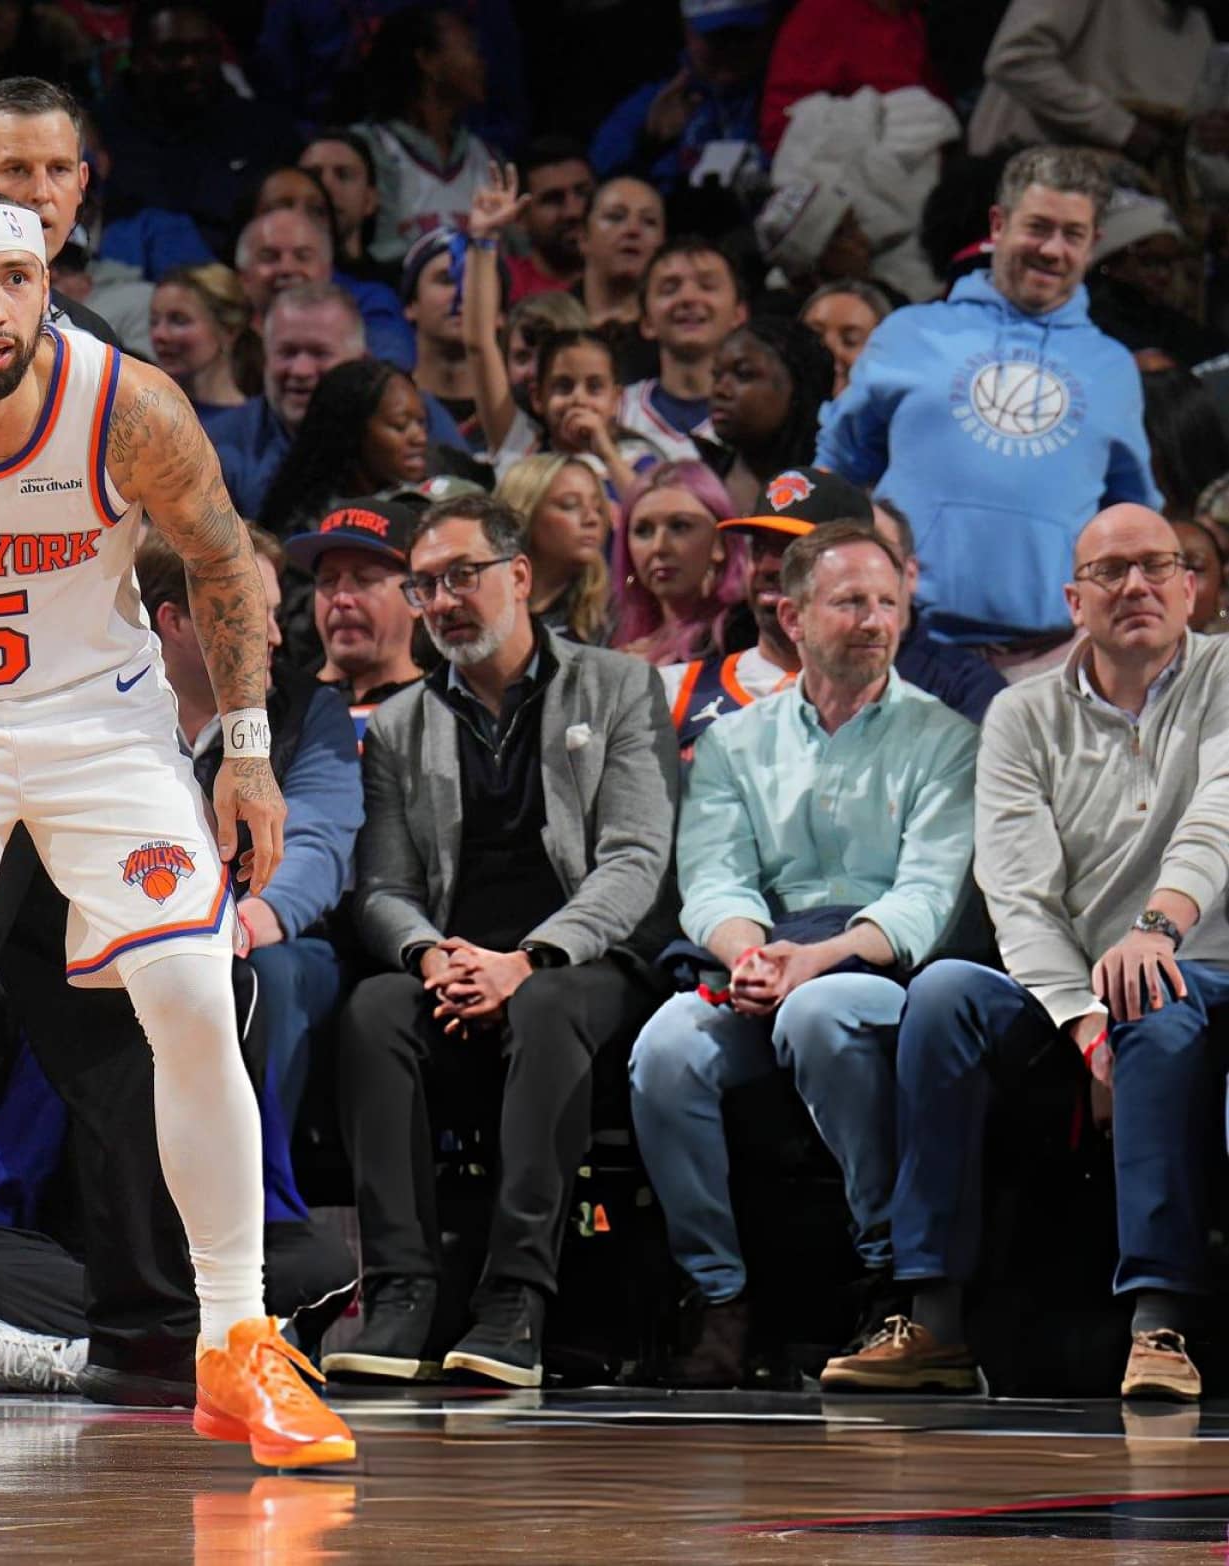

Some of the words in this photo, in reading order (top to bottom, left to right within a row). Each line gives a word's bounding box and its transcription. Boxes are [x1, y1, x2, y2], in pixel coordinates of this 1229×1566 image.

[20, 484, 45, 494] abu
[46, 479, 83, 492] dhabi
[319, 510, 347, 536] NEW
[345, 507, 390, 538] YORK
[122, 845, 197, 886] KNICKS
